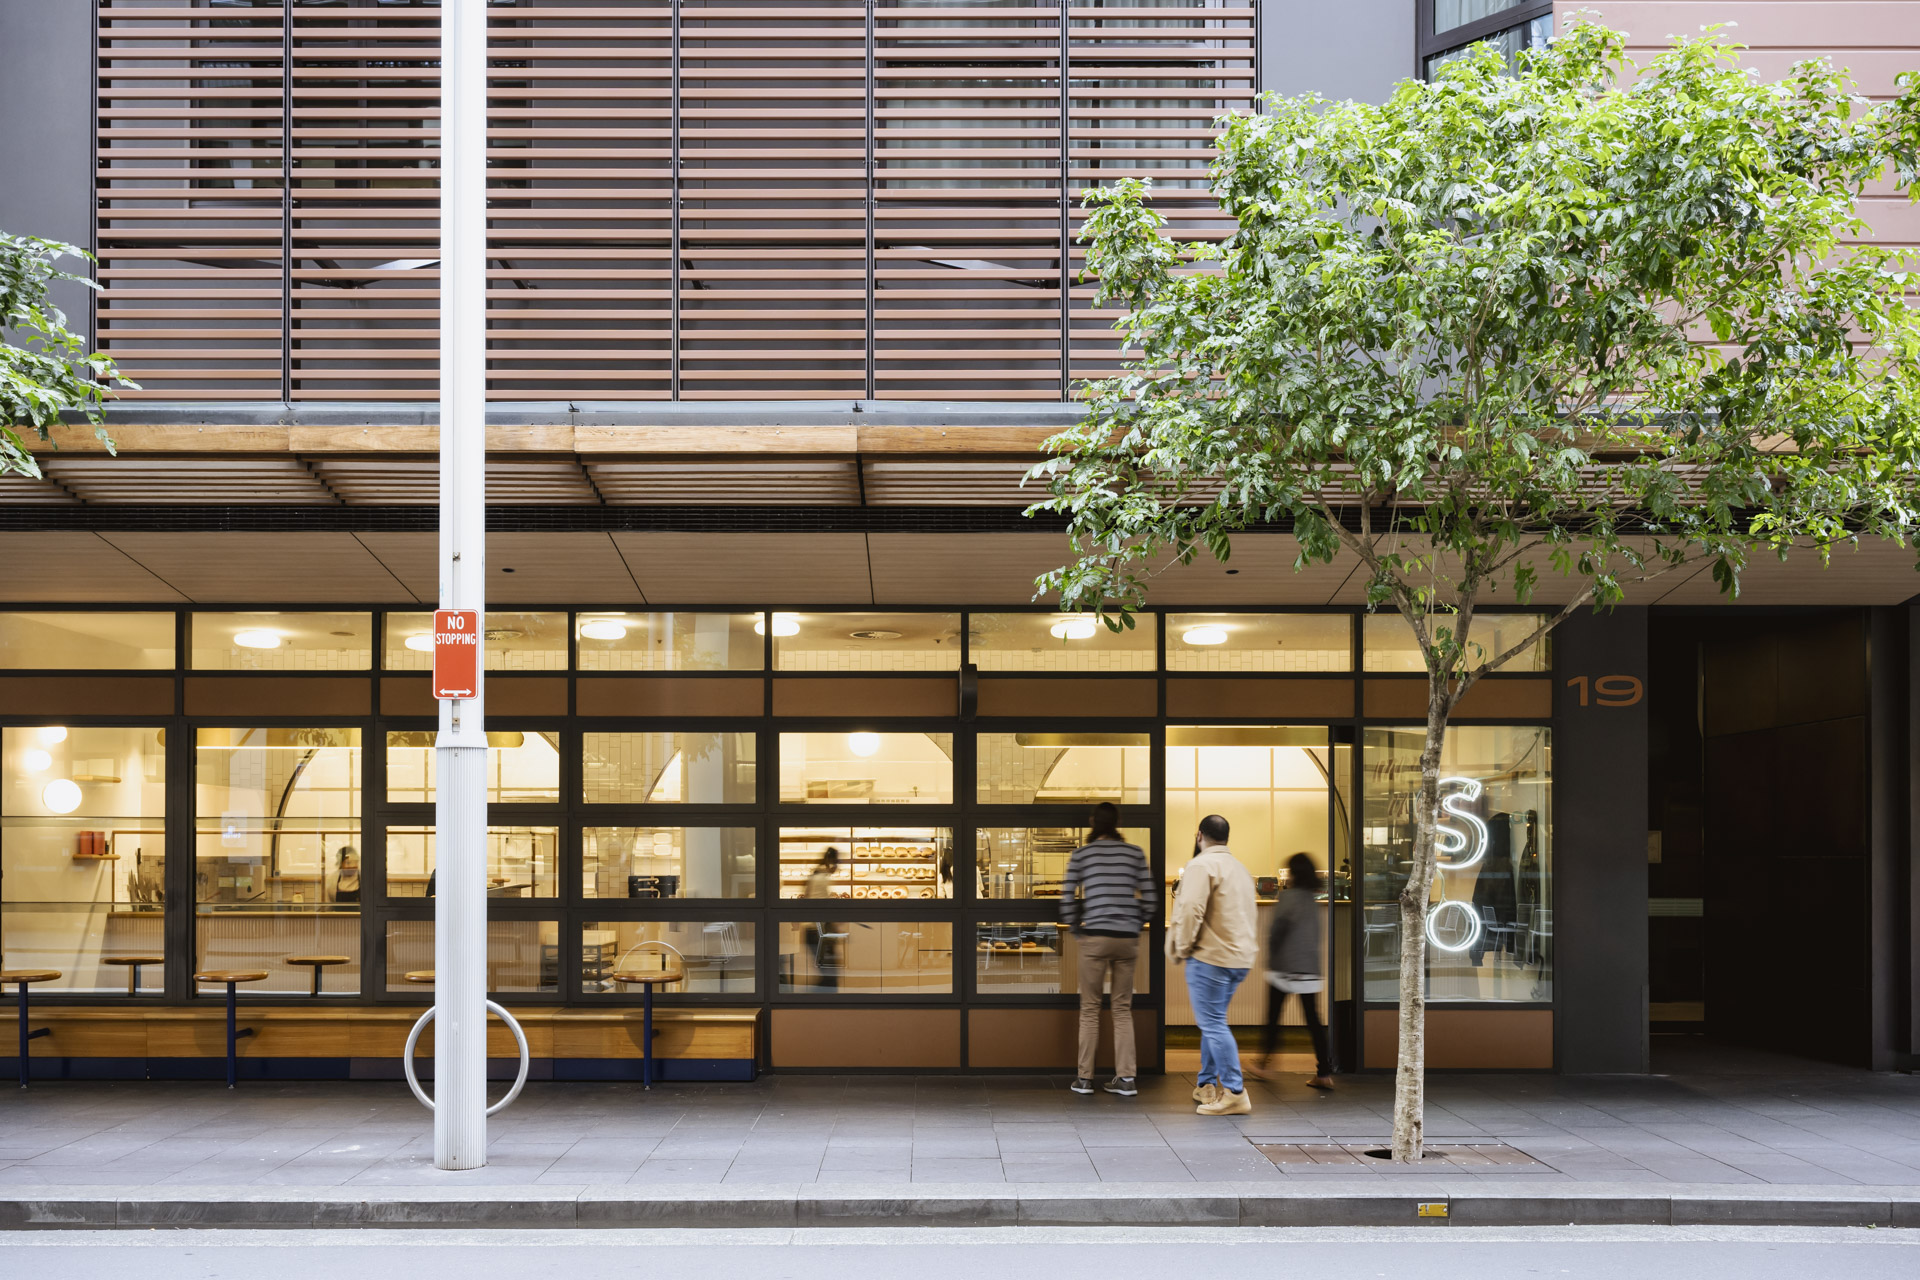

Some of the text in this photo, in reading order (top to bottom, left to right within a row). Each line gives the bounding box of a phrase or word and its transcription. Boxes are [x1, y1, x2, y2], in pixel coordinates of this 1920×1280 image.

[447, 616, 465, 630] NO
[436, 633, 476, 645] STOPPING
[1567, 675, 1643, 707] 19
